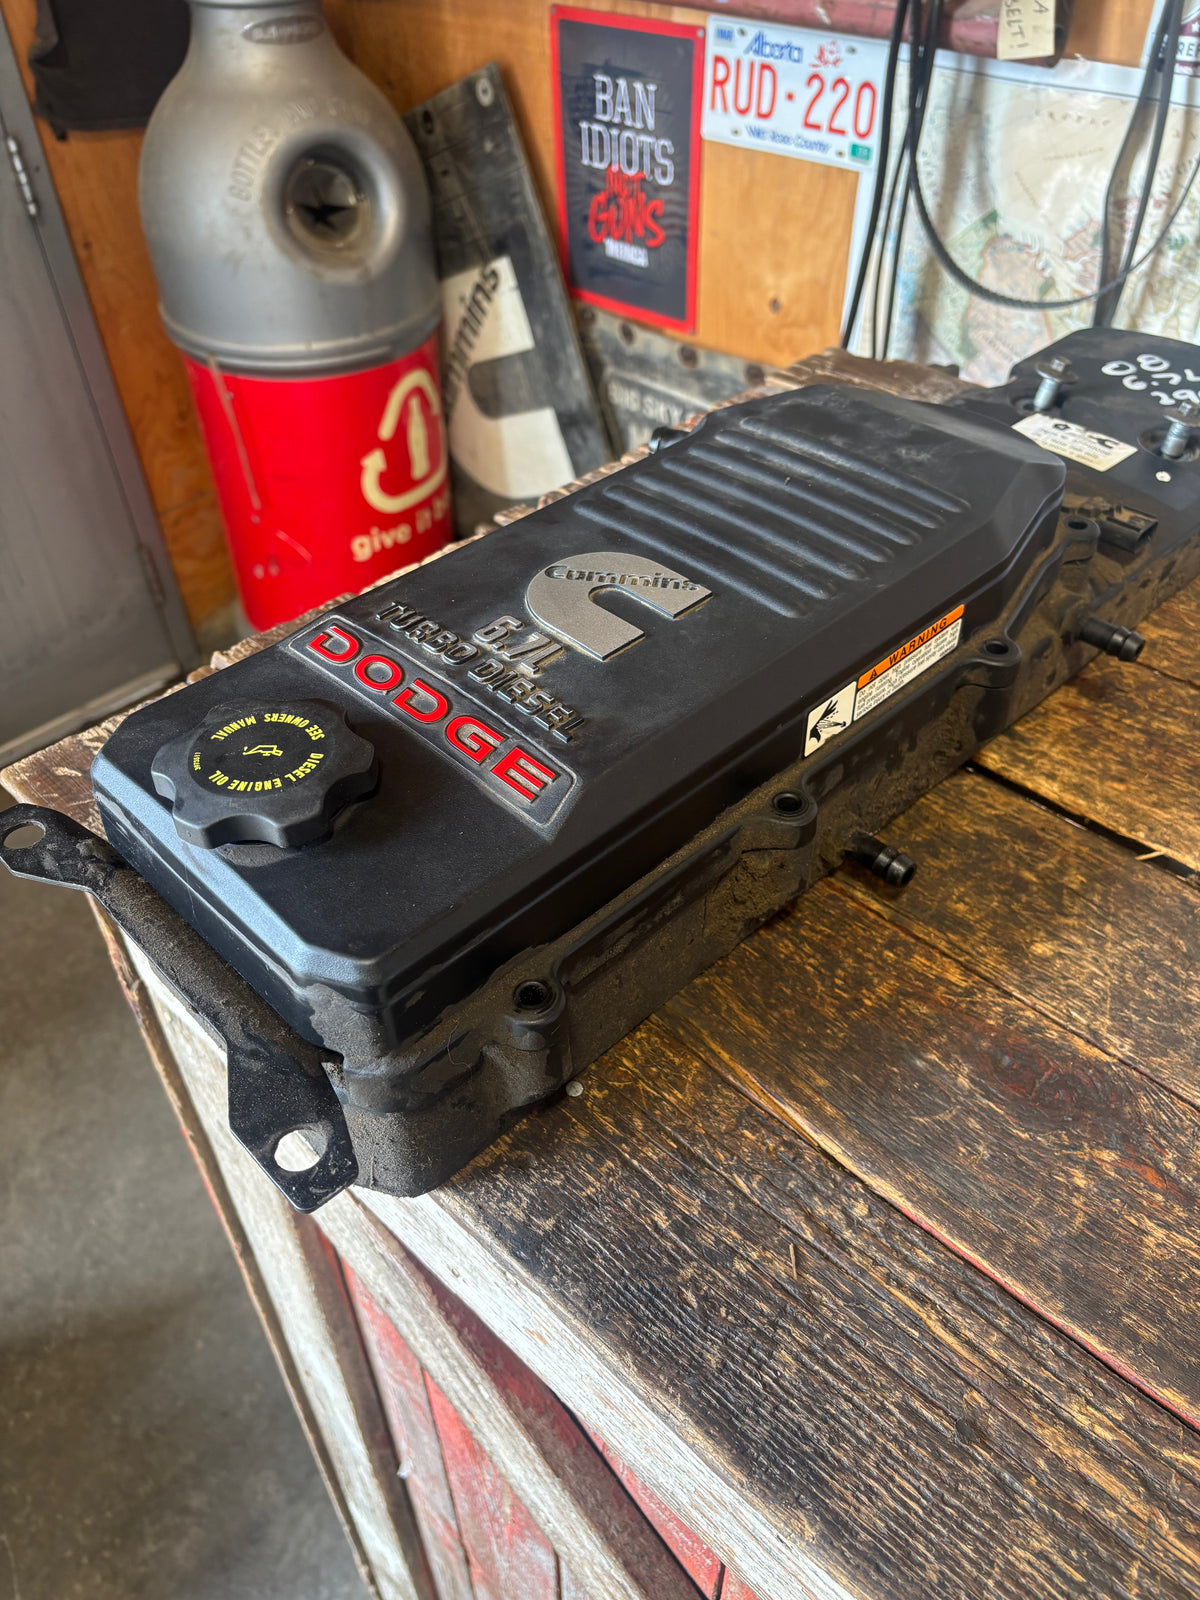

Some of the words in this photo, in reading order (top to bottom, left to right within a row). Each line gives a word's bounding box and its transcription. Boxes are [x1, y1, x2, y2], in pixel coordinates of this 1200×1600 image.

[743, 30, 804, 63] Alberta
[593, 73, 657, 131] BAN
[579, 121, 675, 186] IDIOTS
[606, 163, 647, 199] NOT
[588, 191, 666, 248] GUNS
[351, 523, 413, 563] give
[544, 566, 701, 592] Cummins
[473, 614, 565, 675] 6.7L
[889, 618, 947, 666] WARNING
[376, 601, 479, 666] TURBO
[467, 658, 584, 743] DIESEL
[210, 715, 257, 741] MANUAL
[264, 713, 310, 729] OWNERS
[306, 625, 558, 803] DODGE
[305, 724, 326, 741] SEE
[208, 769, 230, 786] OIL
[227, 778, 283, 792] ENGINE
[284, 752, 325, 782] DIESEL
